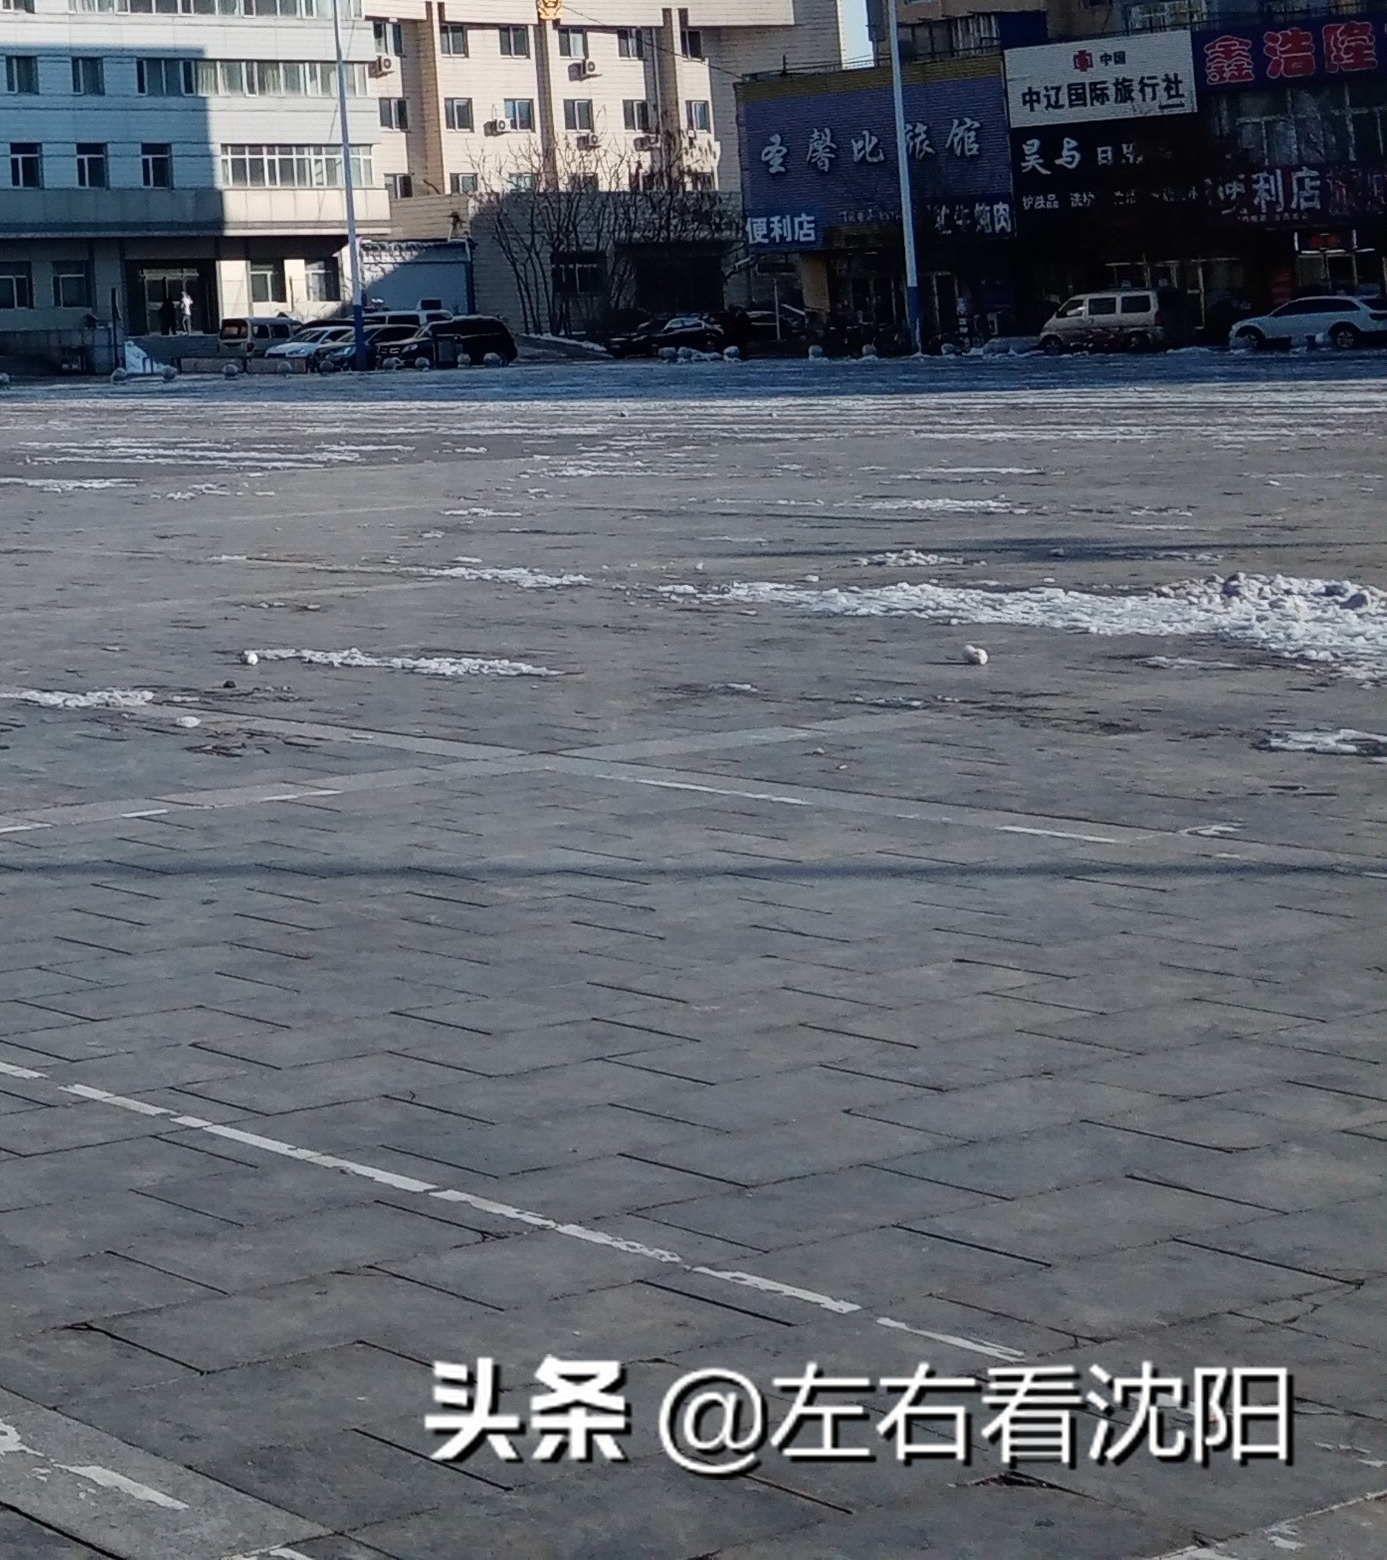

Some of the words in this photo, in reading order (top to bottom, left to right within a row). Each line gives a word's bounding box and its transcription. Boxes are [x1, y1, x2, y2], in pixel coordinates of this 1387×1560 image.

[1099, 50, 1126, 67] 中国
[1020, 72, 1185, 113] 中辽国际旅行社
[745, 213, 817, 245] 便利店
